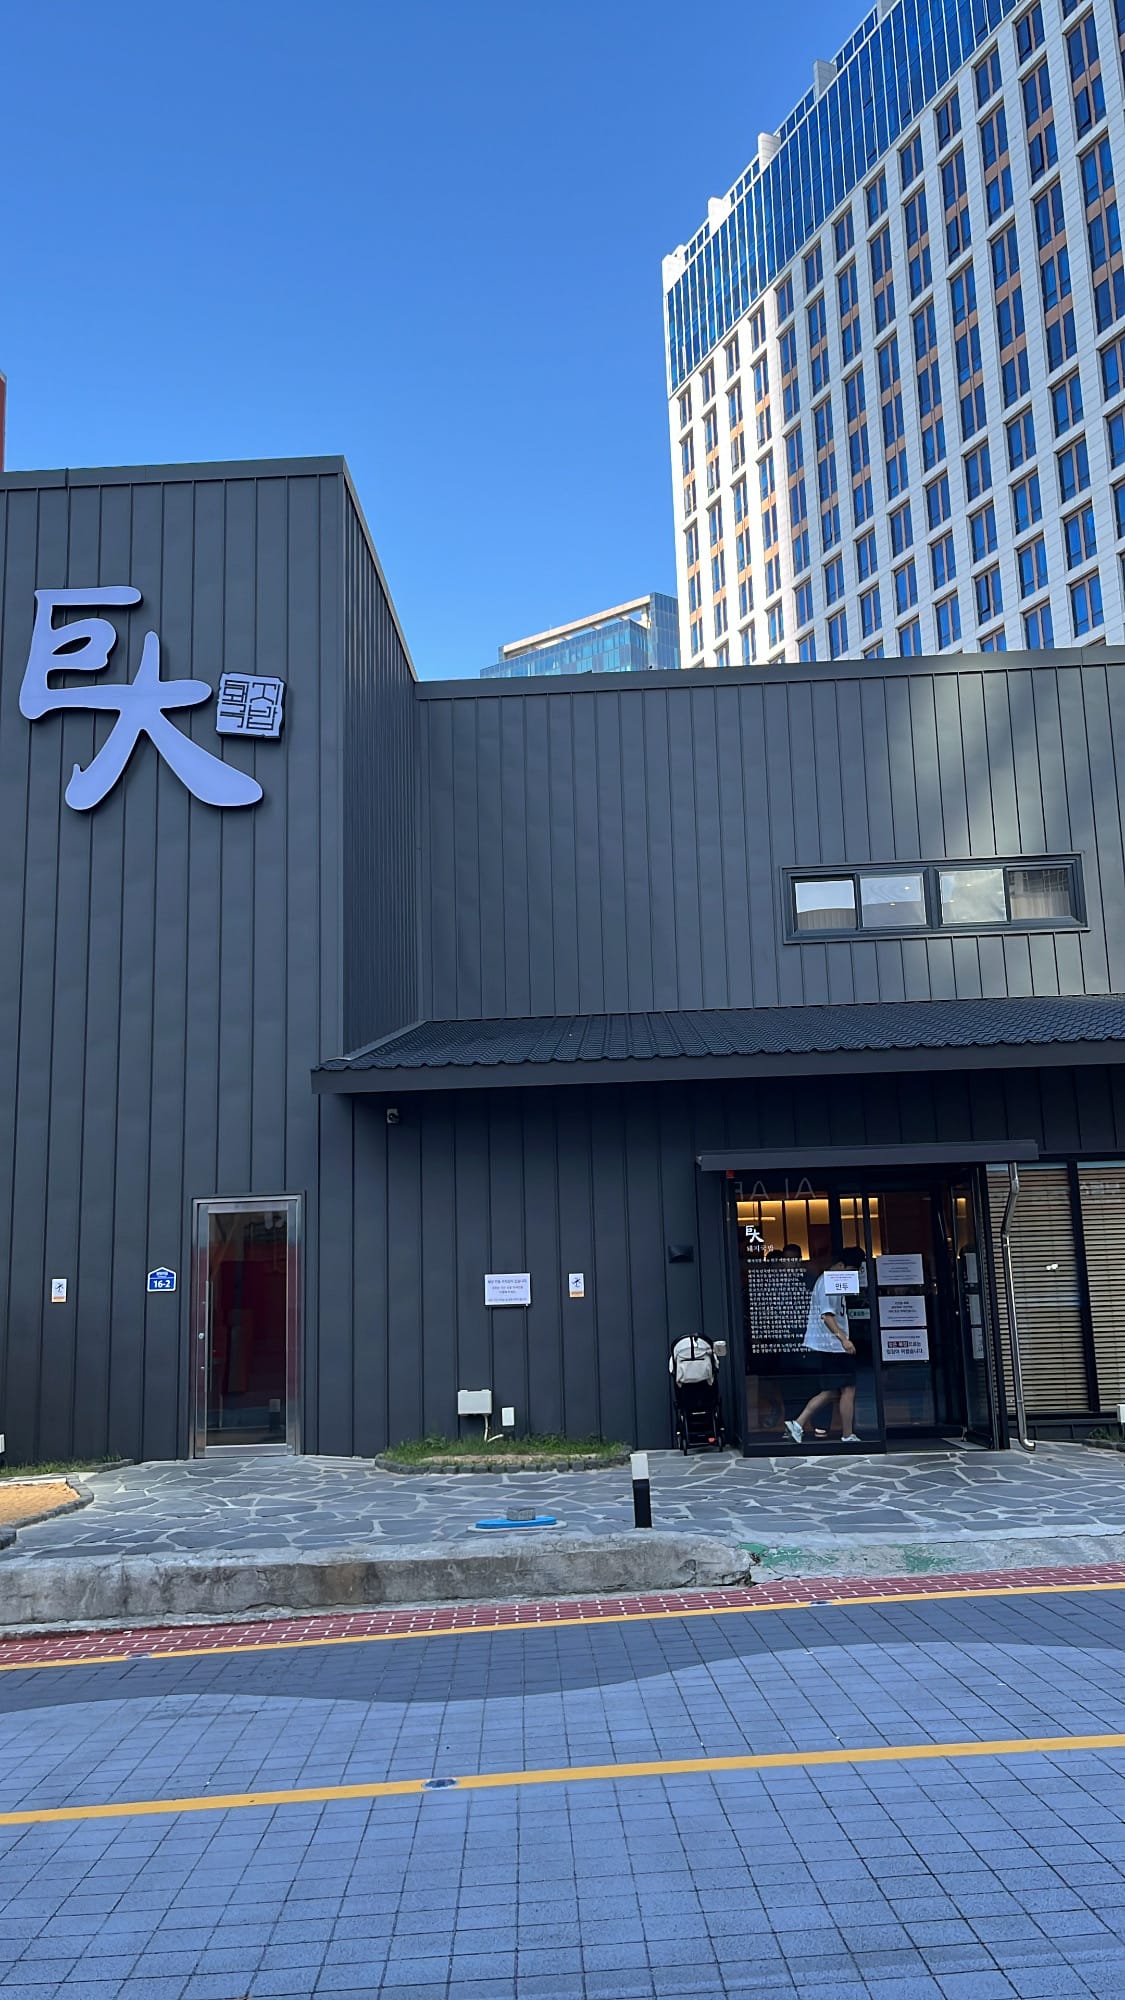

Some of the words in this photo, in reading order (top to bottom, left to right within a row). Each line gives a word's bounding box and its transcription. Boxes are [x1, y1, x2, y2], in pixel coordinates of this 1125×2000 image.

[19, 586, 263, 811] 巨大
[153, 1279, 171, 1289] 16-2
[835, 1282, 849, 1291] 만두
